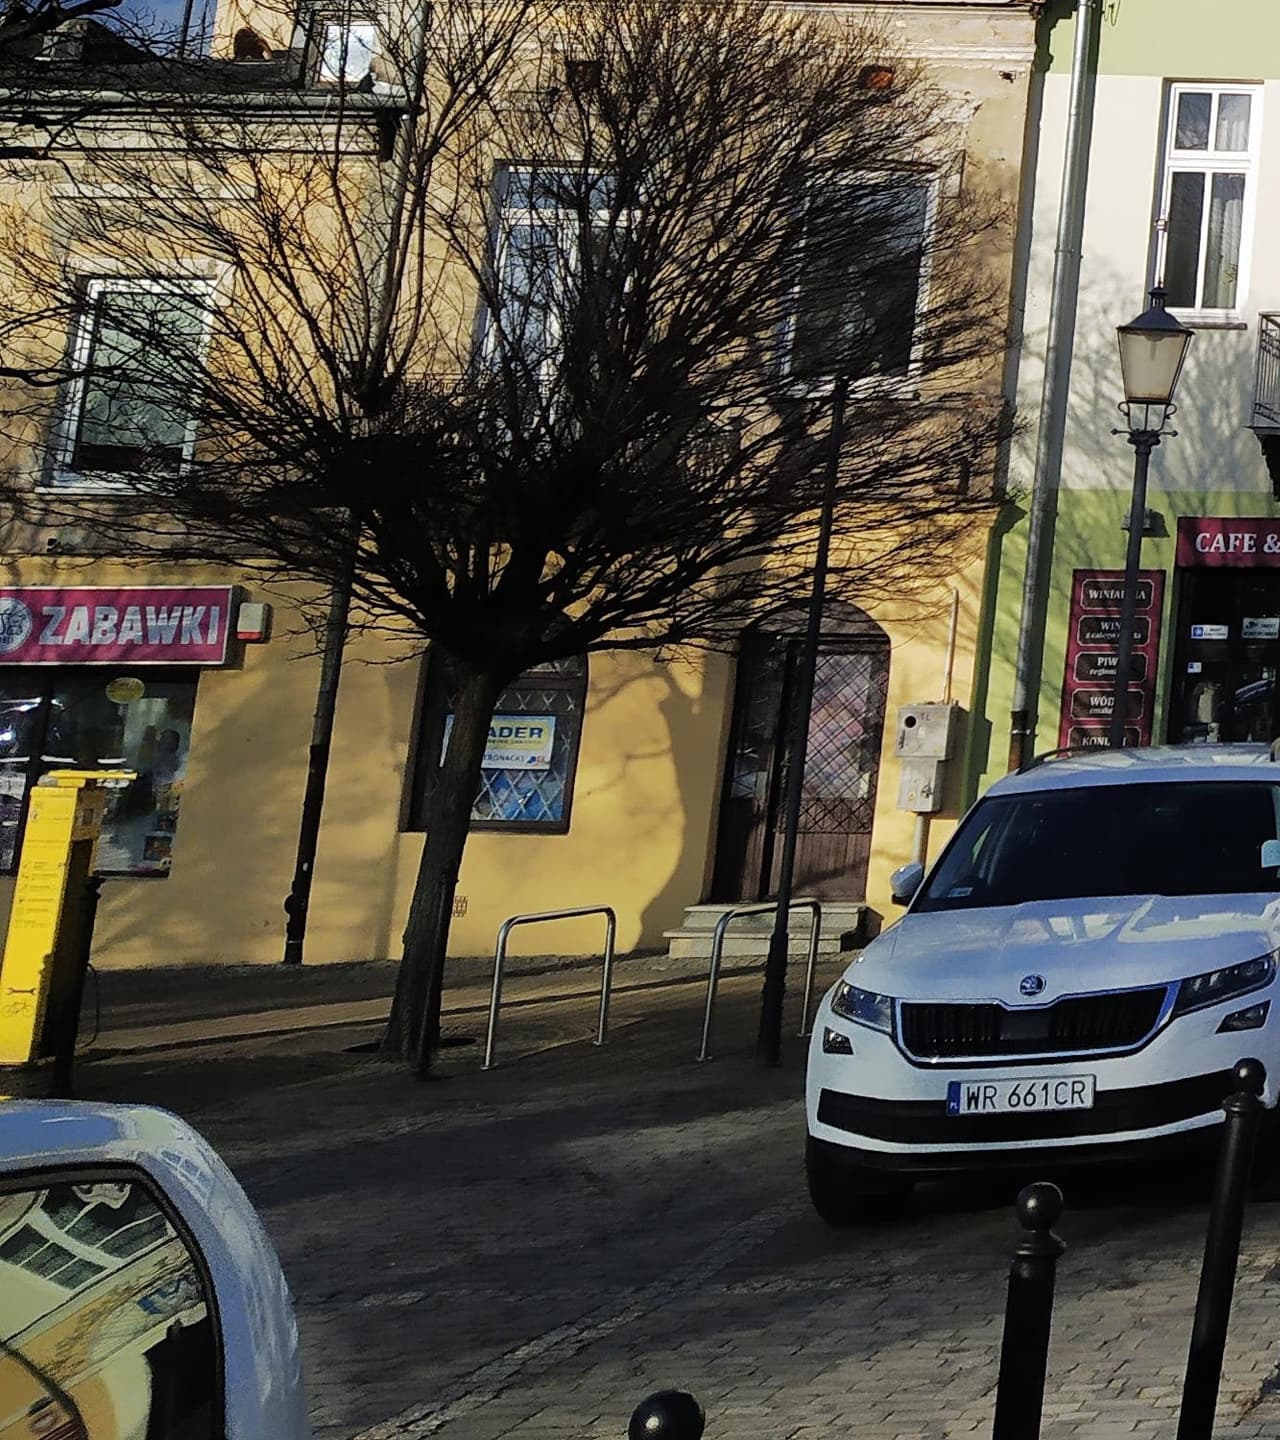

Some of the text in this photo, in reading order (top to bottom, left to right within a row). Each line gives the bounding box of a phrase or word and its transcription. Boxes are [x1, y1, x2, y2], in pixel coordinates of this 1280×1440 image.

[1195, 532, 1257, 553] CAFE
[39, 606, 220, 645] ZABAWKI
[1101, 621, 1121, 631] WIN
[1097, 657, 1119, 666] PIW
[1090, 696, 1115, 706] WÓD
[488, 726, 543, 738] ADER
[966, 1080, 1086, 1111] WR 661CR
